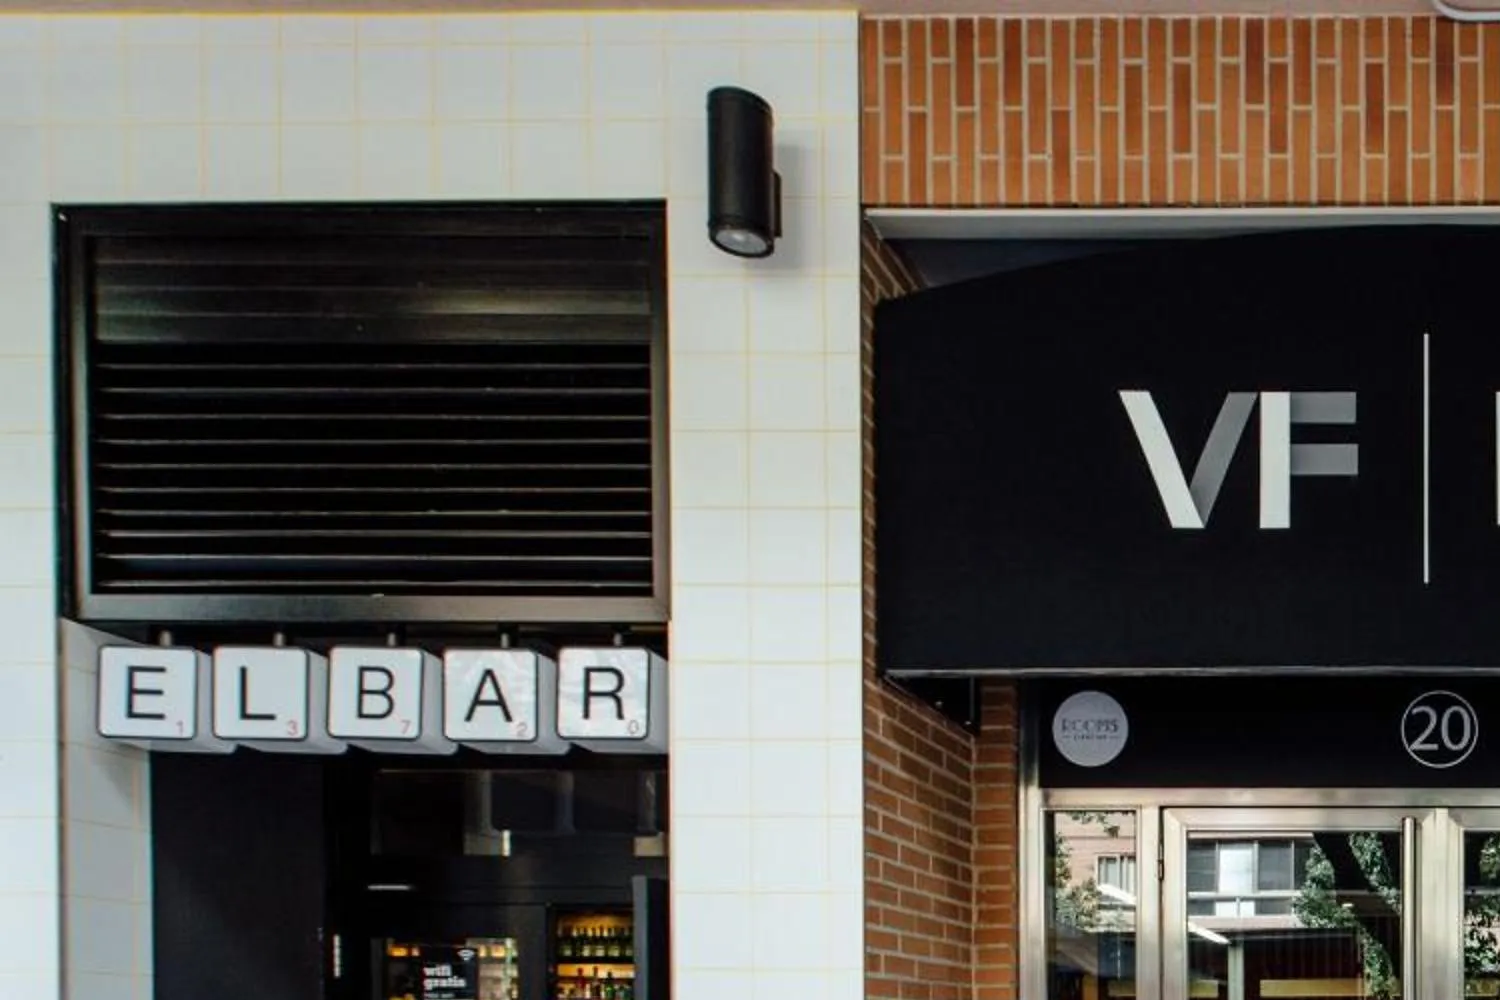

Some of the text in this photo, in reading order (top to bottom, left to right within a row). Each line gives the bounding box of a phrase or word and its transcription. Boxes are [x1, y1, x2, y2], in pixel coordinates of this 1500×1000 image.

[1118, 390, 1359, 529] VF
[175, 722, 185, 736] 1
[286, 722, 299, 736] 3
[400, 721, 412, 735] 7
[516, 722, 529, 737] 2
[1411, 705, 1472, 751] 20
